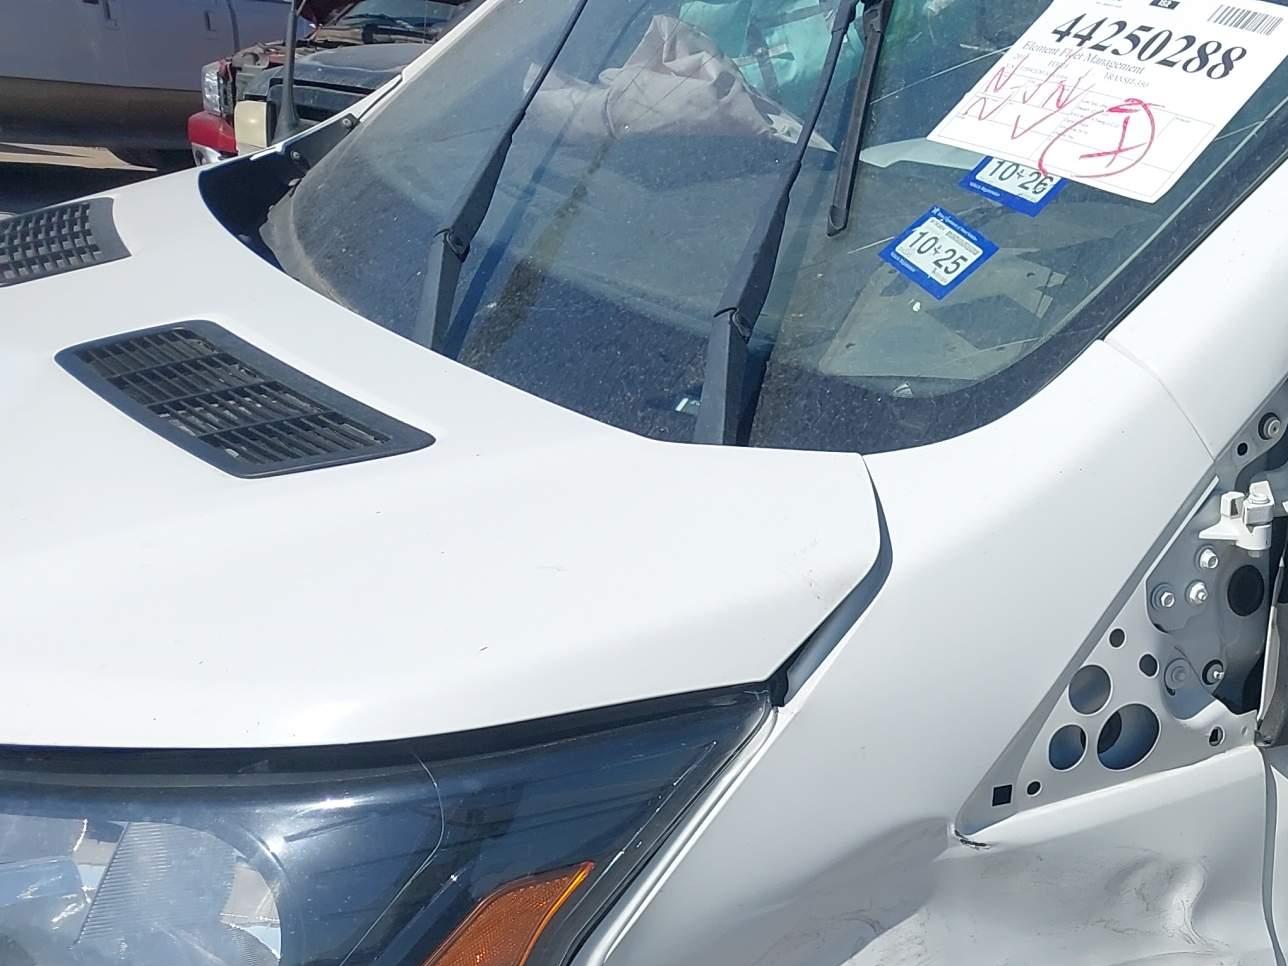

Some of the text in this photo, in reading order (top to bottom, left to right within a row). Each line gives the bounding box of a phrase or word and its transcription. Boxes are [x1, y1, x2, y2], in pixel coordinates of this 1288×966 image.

[1022, 40, 1060, 58] Element
[1084, 52, 1146, 75] Management
[1051, 13, 1247, 79] 44250288
